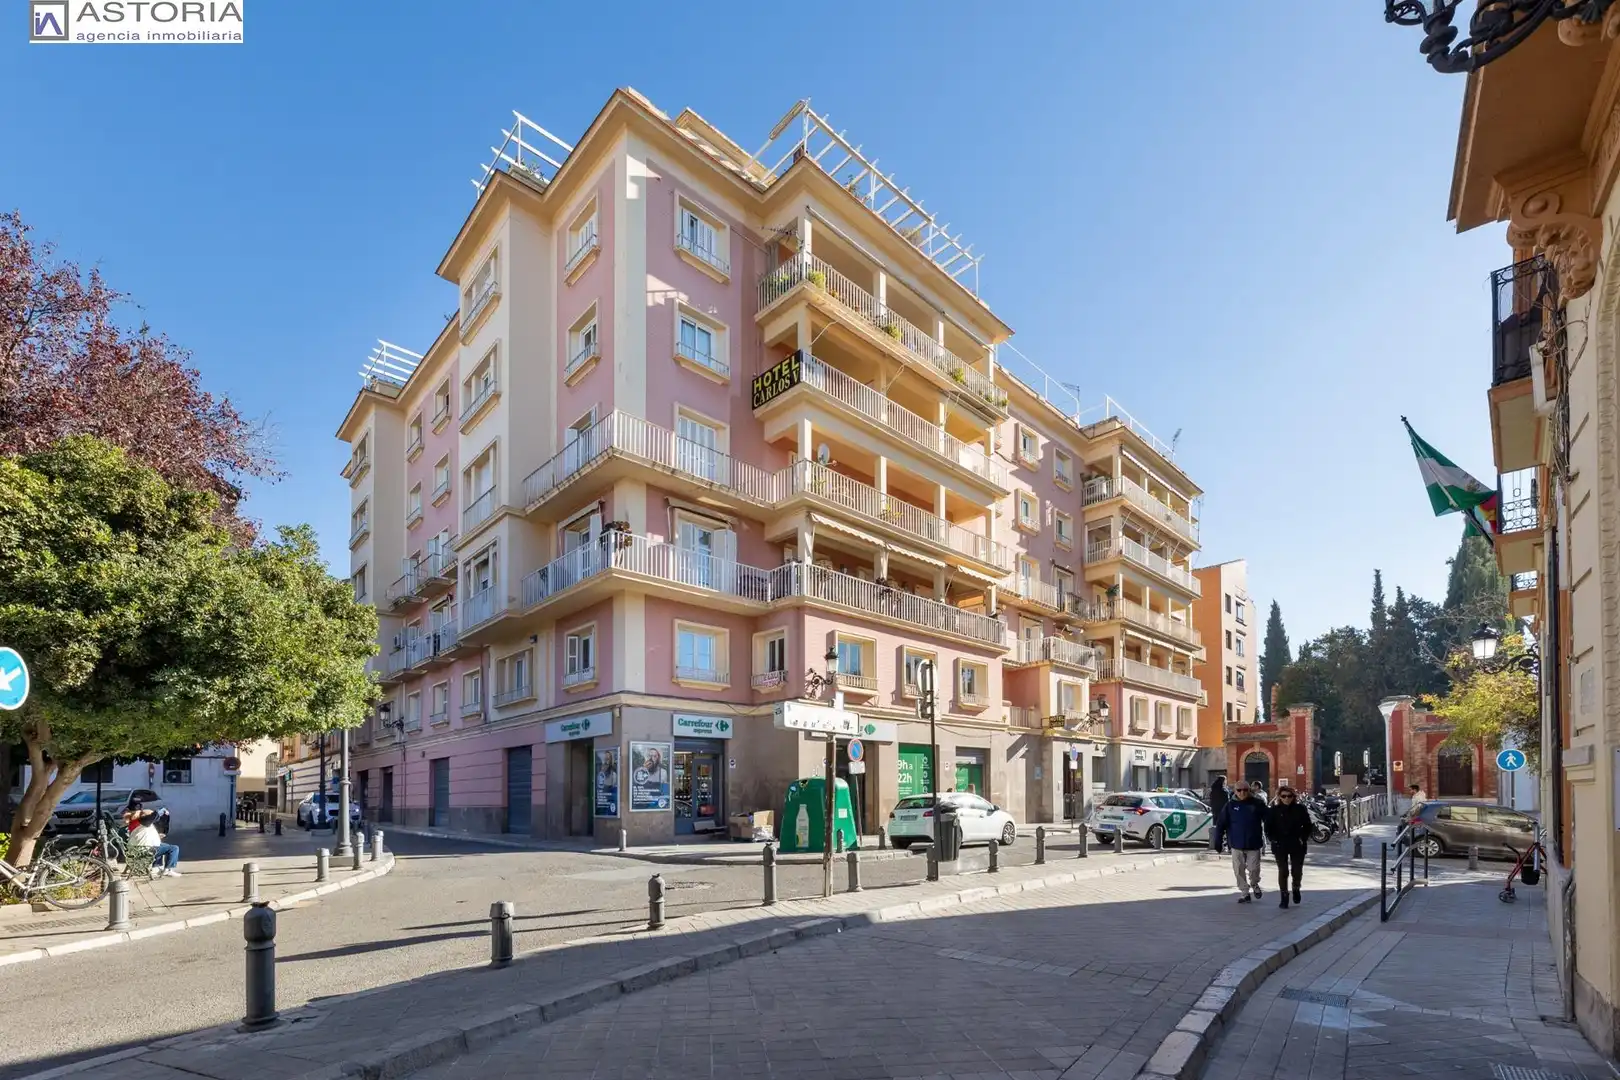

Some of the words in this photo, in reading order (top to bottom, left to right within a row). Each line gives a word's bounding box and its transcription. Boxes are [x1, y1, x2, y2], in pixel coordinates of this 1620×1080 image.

[753, 355, 800, 394] HOTEL
[753, 374, 791, 408] CARLOS
[677, 717, 713, 728] Carrefour
[897, 759, 908, 770] 9h
[897, 772, 912, 784] 22h
